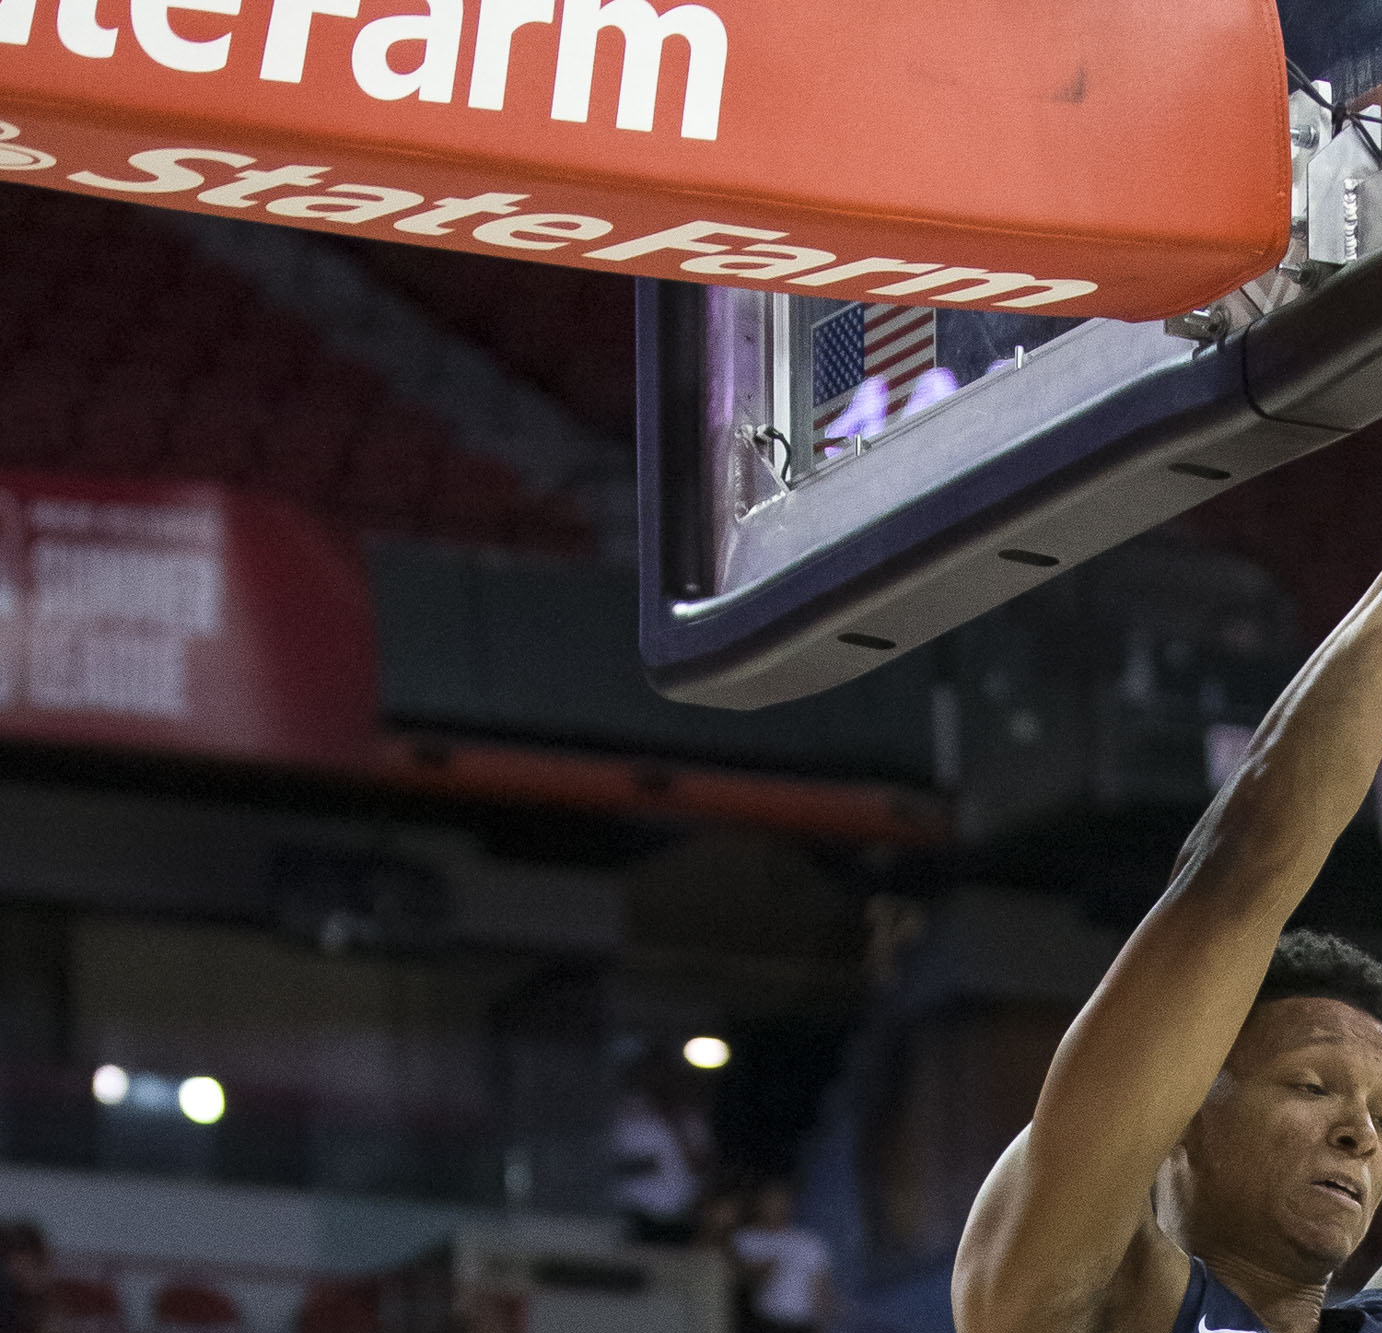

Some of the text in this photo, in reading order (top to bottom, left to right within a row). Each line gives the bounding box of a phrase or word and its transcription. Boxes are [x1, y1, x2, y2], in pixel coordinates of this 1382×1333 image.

[259, 0, 728, 141] Farm
[66, 148, 1098, 308] State Farm
